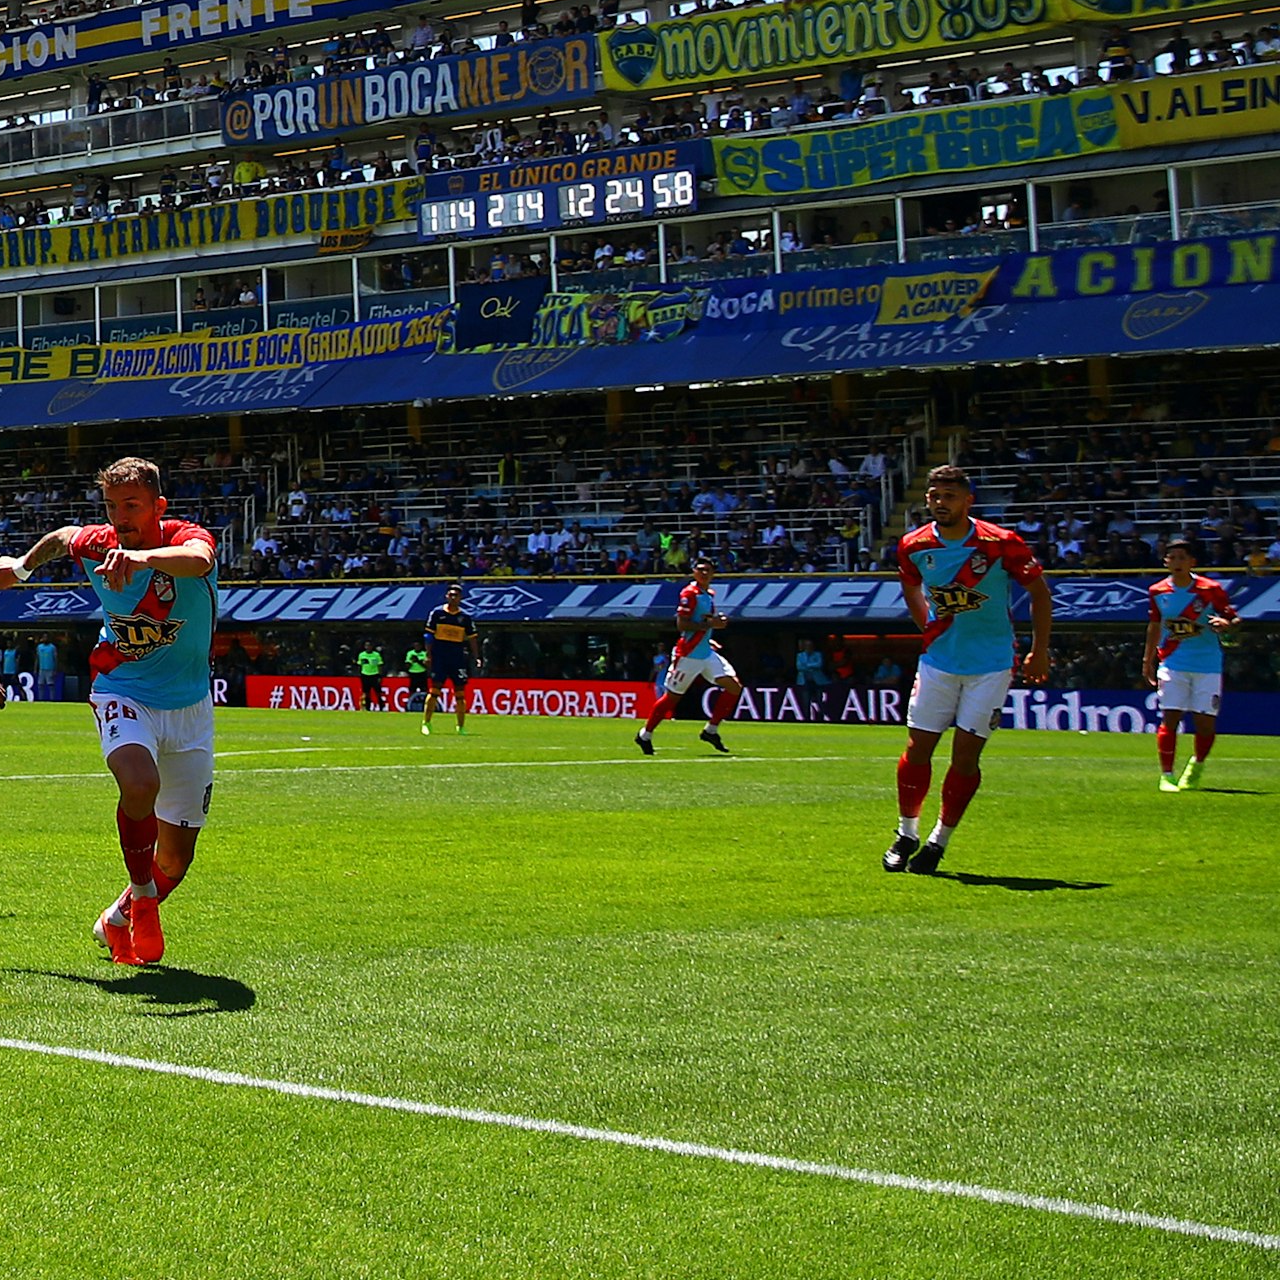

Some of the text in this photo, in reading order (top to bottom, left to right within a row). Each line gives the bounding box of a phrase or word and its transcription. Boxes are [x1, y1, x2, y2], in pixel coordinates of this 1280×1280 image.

[761, 97, 1083, 193] SUPER BOCA
[479, 149, 678, 192] EL ÚNICO GRANDE
[68, 204, 240, 263] ALTERNATIVA
[254, 182, 397, 239] BOQUENSE
[705, 288, 775, 320] BOCA
[905, 278, 979, 301] VOLVER
[192, 318, 246, 337] Fiertel
[895, 304, 910, 319] A
[101, 333, 303, 378] AGRUPACION DALE BOCA
[807, 335, 982, 362] AIRWAYS
[181, 384, 307, 408] AIRWAYS
[289, 685, 360, 712] NADA
[466, 689, 487, 715] A
[490, 689, 638, 719] GATORADE
